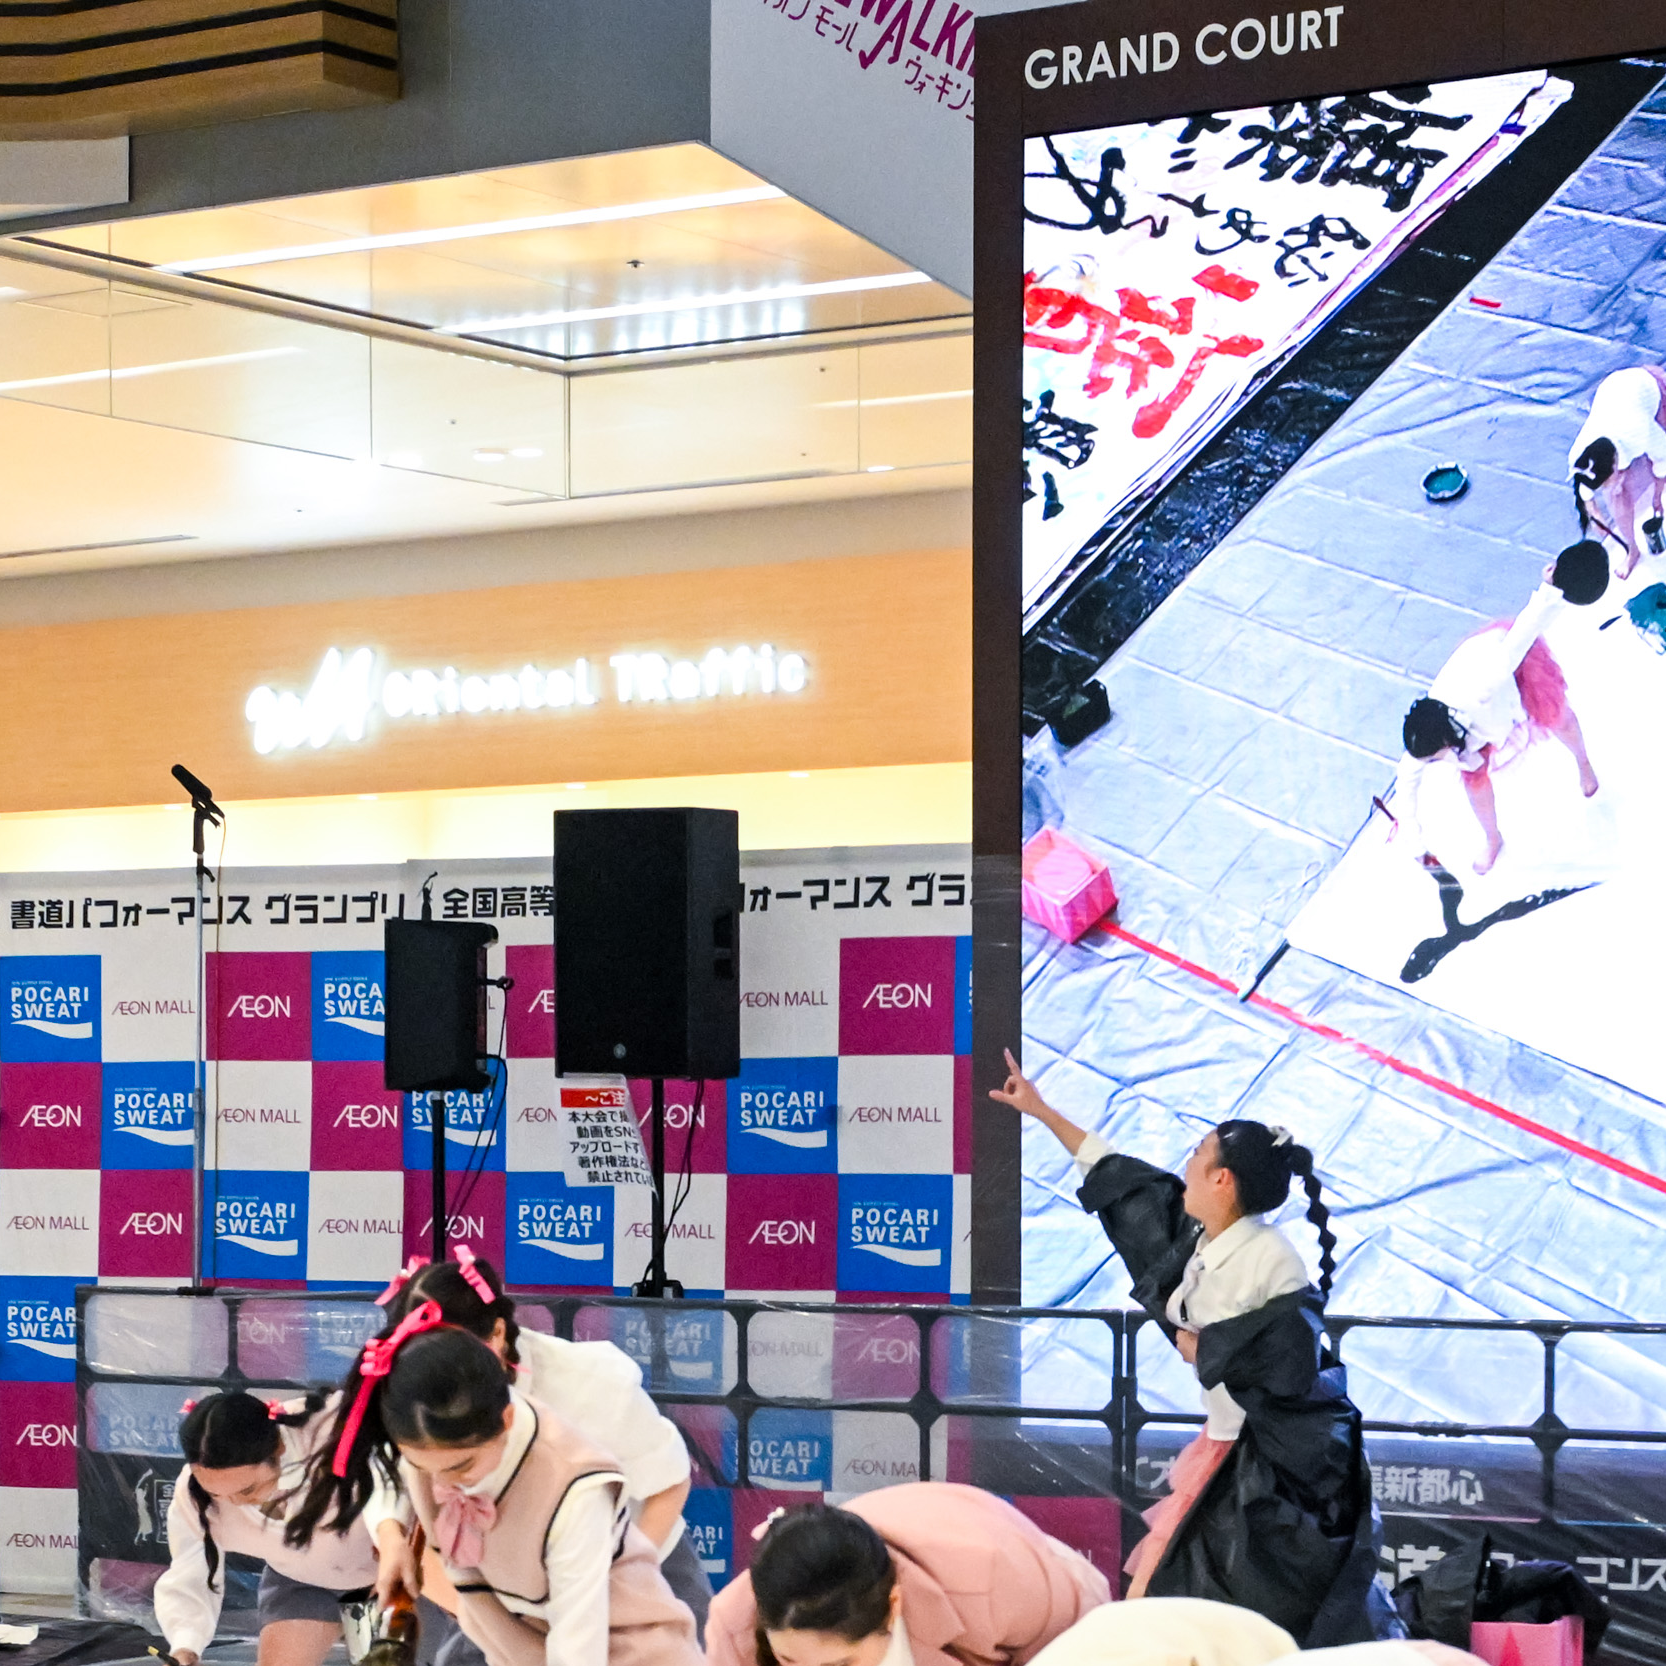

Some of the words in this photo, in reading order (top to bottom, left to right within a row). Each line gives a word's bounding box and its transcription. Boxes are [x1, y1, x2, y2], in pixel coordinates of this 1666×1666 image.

[1024, 32, 1179, 89] GRAND
[1195, 7, 1343, 61] COURT
[905, 56, 974, 121] ウォーキン
[442, 885, 555, 919] 全国高等
[740, 875, 891, 913] ォーマンス
[907, 873, 971, 906] グラ
[11, 986, 89, 1003] POCARI
[324, 983, 383, 999] POCA
[784, 991, 828, 1007] MALL
[11, 1003, 82, 1019] SWEAT
[154, 1000, 195, 1015] MALL
[324, 1000, 385, 1016] SWEA
[114, 1093, 193, 1109] POCARI
[740, 1092, 824, 1108] POCARI
[114, 1109, 186, 1125] SWEAT
[260, 1108, 301, 1124] MALL
[740, 1108, 816, 1126] SWEAT
[897, 1107, 942, 1123] MALL
[215, 1202, 296, 1219] POCARI
[519, 1205, 601, 1221] POCARI
[851, 1208, 939, 1226] POCARI
[49, 1216, 89, 1231] MALL
[215, 1218, 288, 1235] SWEAT
[364, 1219, 403, 1234] MALL
[519, 1222, 594, 1238] SWEAT
[851, 1226, 930, 1243] SWEAT
[7, 1306, 76, 1322] POCAR
[7, 1322, 76, 1337] SWEAT
[750, 1440, 820, 1457] OCARI
[750, 1458, 812, 1475] WEAT
[49, 1534, 78, 1548] MAL
